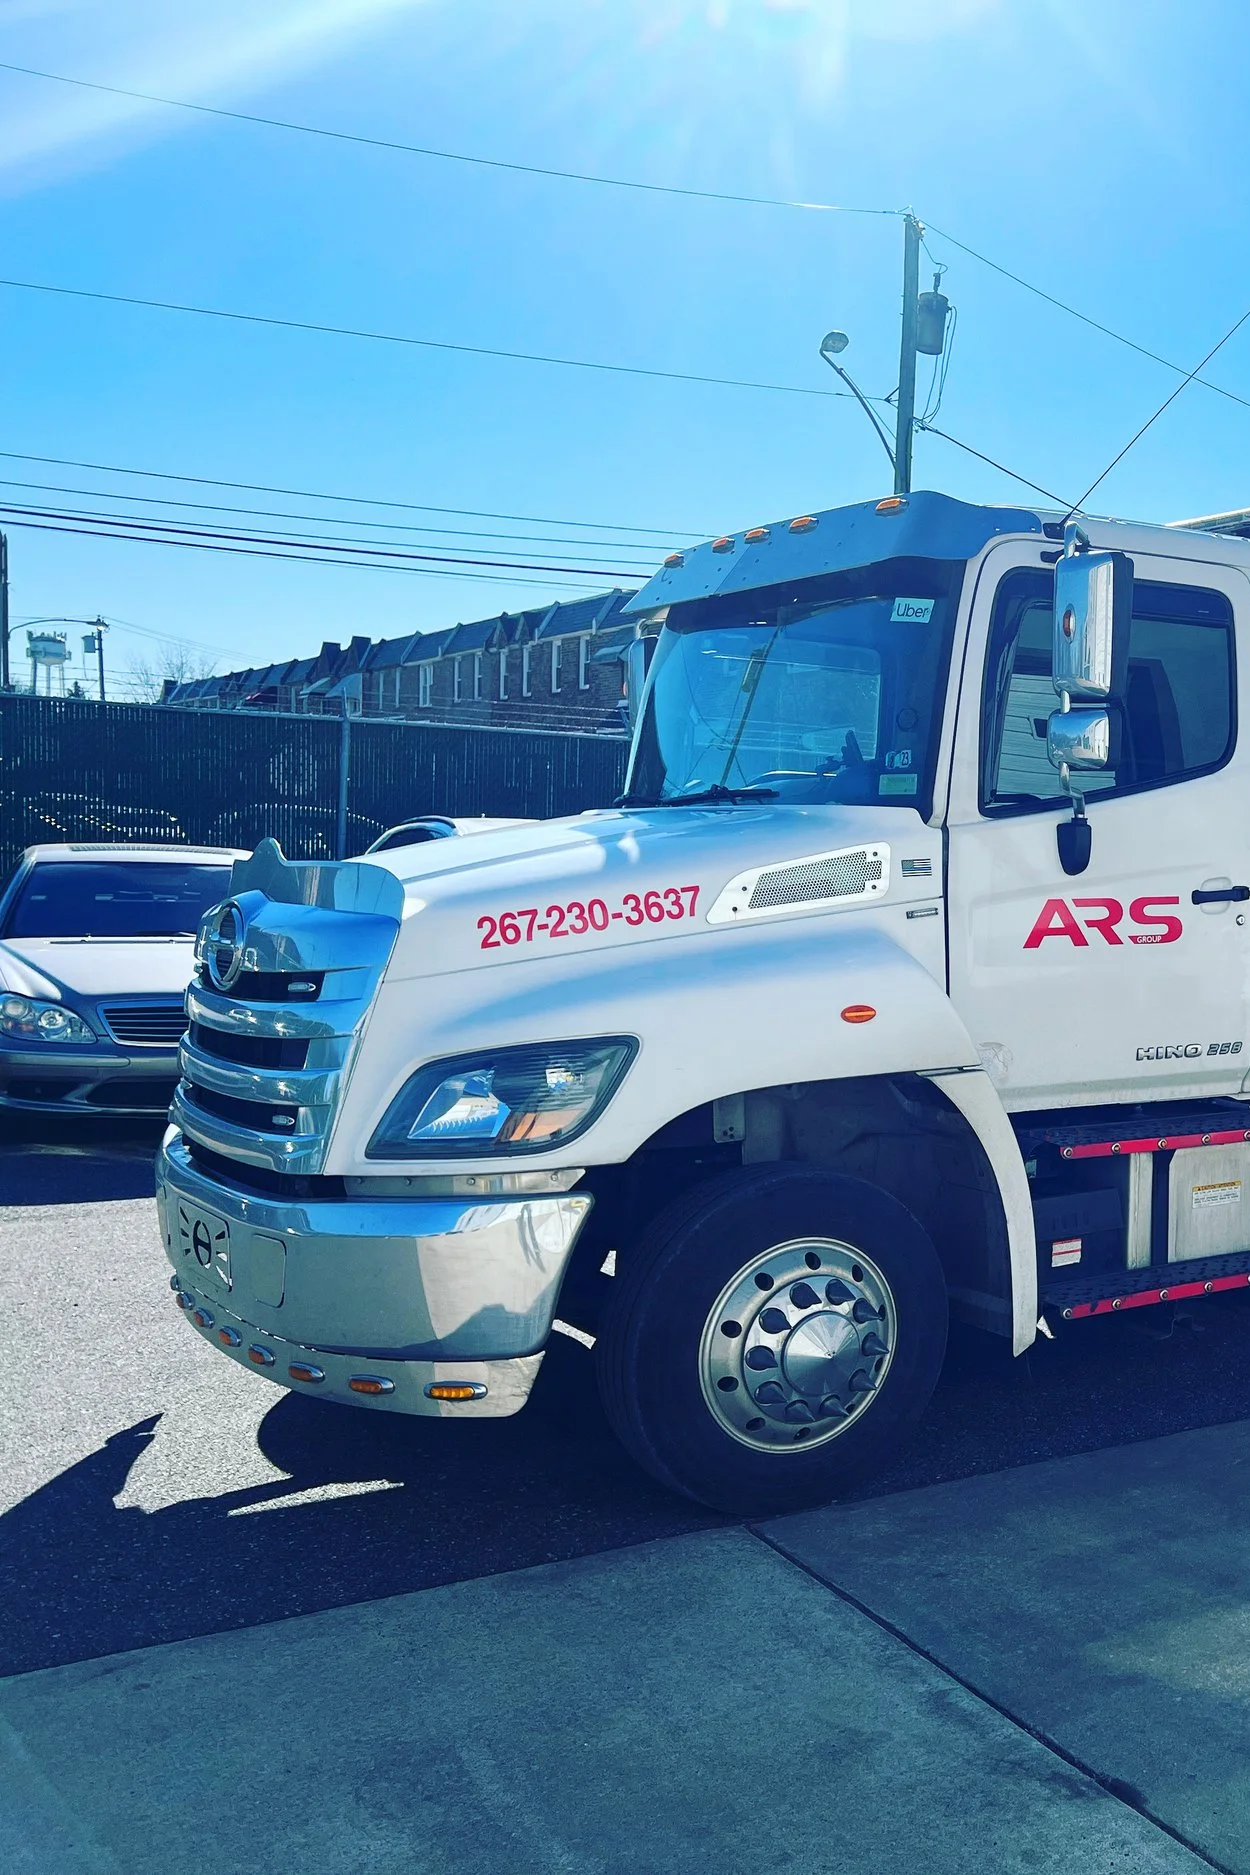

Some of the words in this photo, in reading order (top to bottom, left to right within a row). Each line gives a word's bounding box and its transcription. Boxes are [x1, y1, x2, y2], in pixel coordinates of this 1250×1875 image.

[896, 603, 930, 618] Uber
[476, 885, 701, 949] 267-230-3637
[1022, 895, 1184, 949] ARS
[1136, 935, 1163, 944] GROUP
[1136, 1043, 1203, 1061] HINO
[1207, 1041, 1243, 1056] 258
